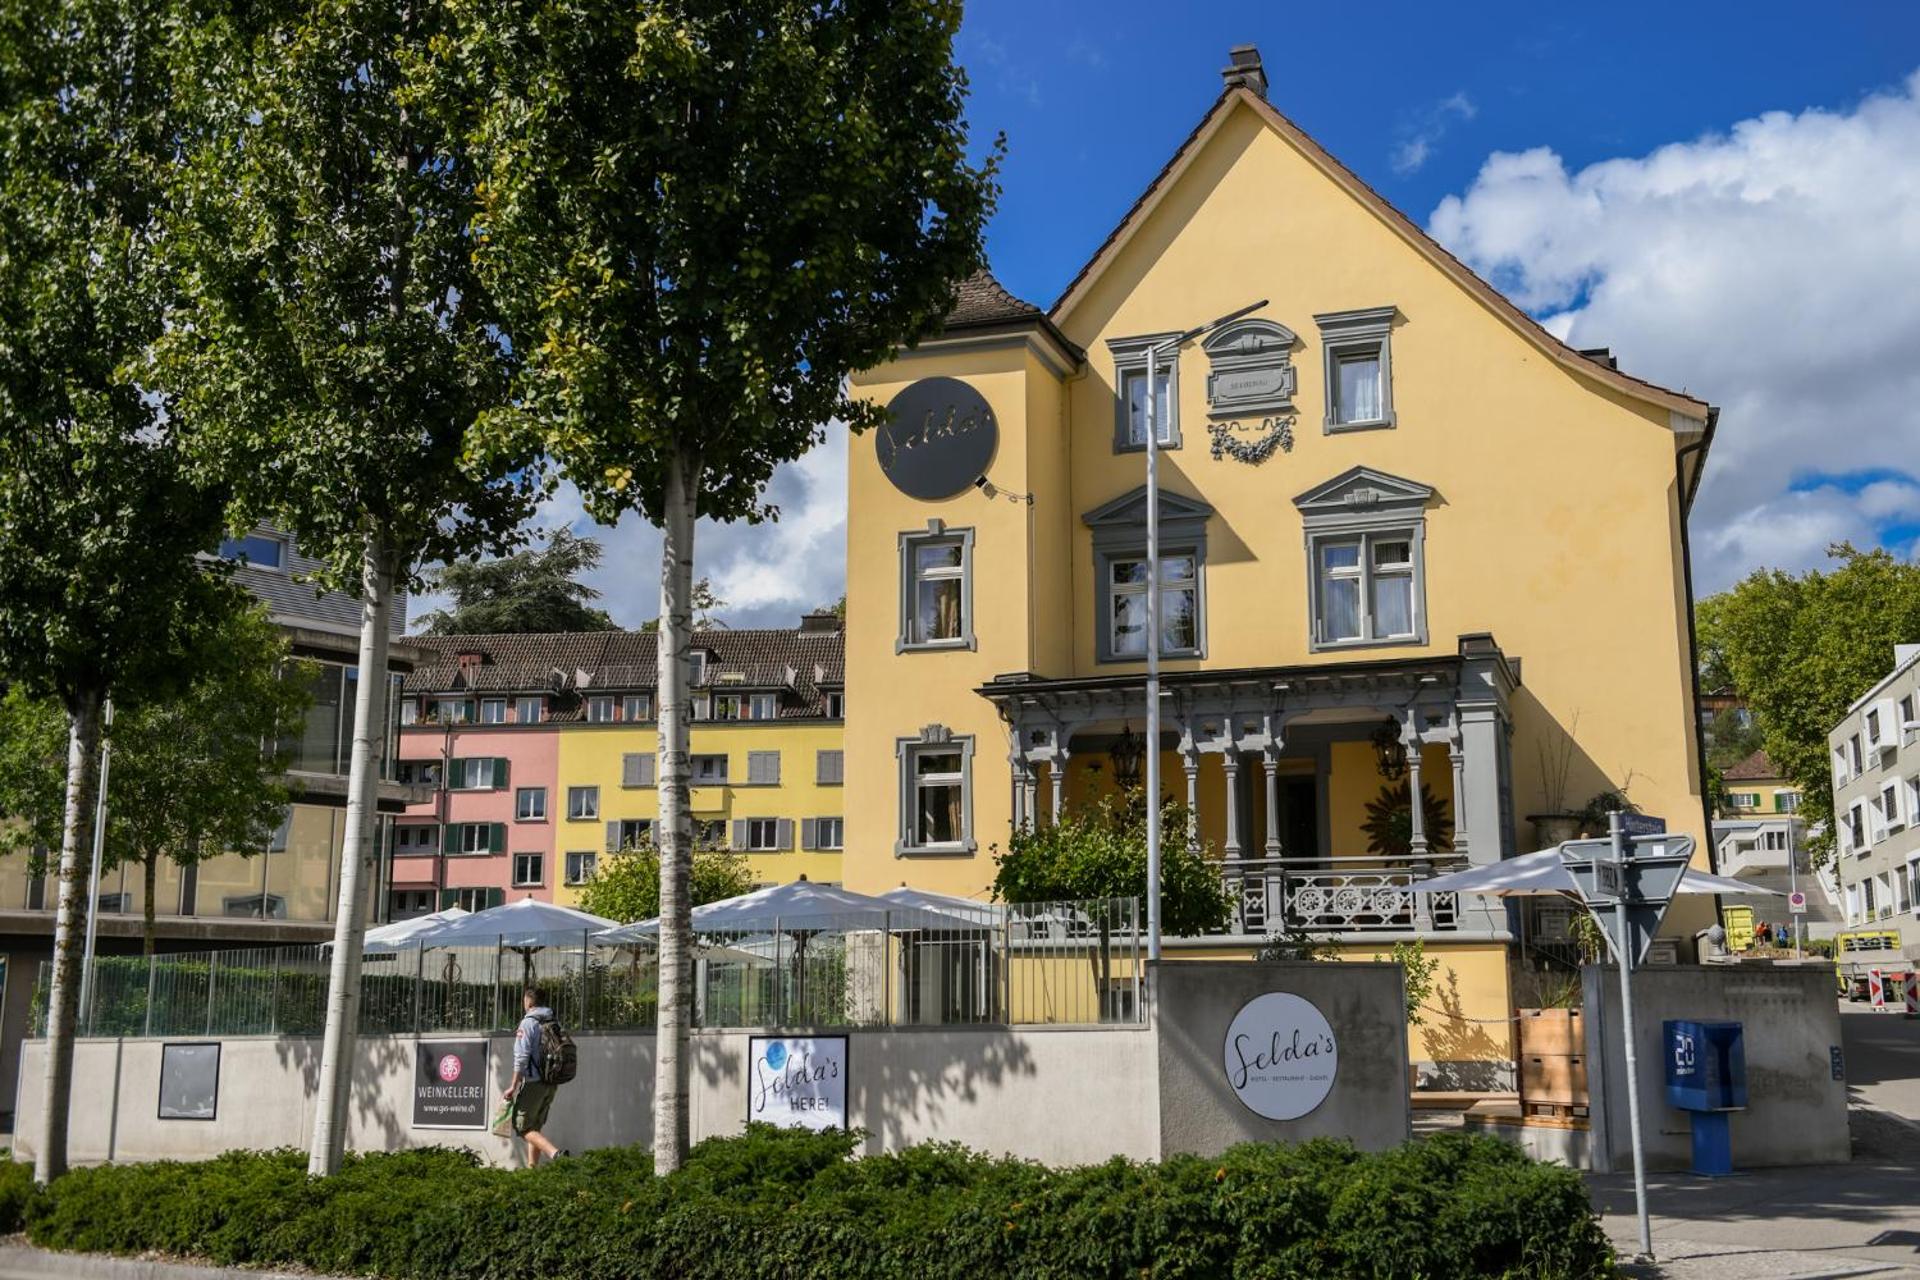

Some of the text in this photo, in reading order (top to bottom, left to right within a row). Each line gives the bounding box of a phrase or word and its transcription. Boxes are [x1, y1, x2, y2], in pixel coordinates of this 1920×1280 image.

[1234, 1029, 1334, 1090] Selda's
[1675, 1034, 1695, 1066] 20
[418, 1086, 484, 1099] WEINKELLEREI
[755, 1052, 838, 1113] Selda's
[790, 1097, 830, 1112] HERE!
